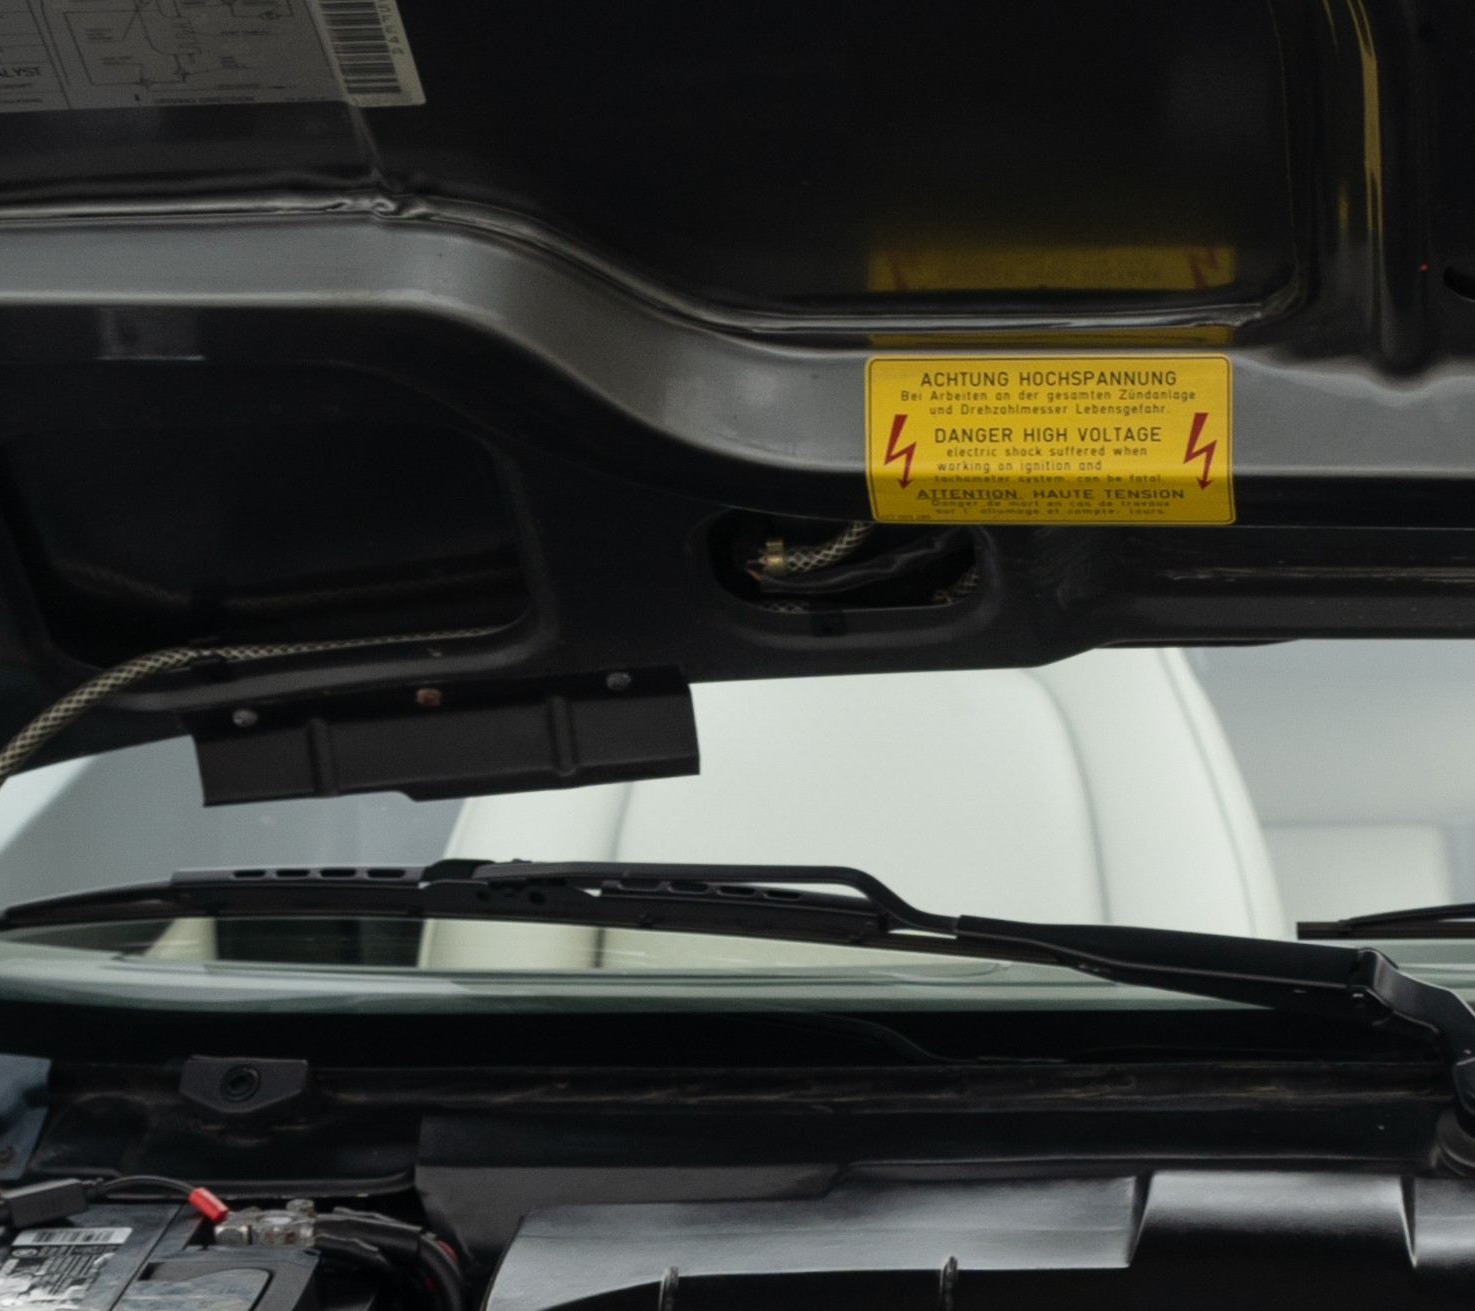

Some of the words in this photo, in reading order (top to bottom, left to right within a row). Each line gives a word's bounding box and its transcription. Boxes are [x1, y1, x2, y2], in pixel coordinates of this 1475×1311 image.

[920, 371, 1009, 388] ACHTUNG
[1018, 370, 1177, 387] HOCHSPANNUNG
[900, 389, 923, 402] Bei
[929, 389, 988, 402] Arbeiten
[994, 391, 1011, 402] an
[1017, 388, 1039, 402] der
[1046, 389, 1112, 404] gesamten
[1118, 387, 1196, 404] Zündanlage
[928, 403, 954, 416] und
[960, 403, 1069, 416] Drehzahlmesser
[934, 427, 1014, 444] DANGER
[1022, 426, 1069, 443] HIGH
[1077, 426, 1163, 443] VOLTAGE
[946, 445, 998, 458] electric
[1004, 445, 1042, 458] shock
[1048, 444, 1106, 458] suffered
[1113, 444, 1148, 457] when
[936, 459, 992, 475] working
[997, 461, 1014, 472] on
[1019, 458, 1072, 474] ignition
[1078, 458, 1102, 472] and
[933, 474, 1011, 484] tachometer
[1078, 474, 1100, 483] can
[1106, 474, 1124, 483] be
[1032, 488, 1094, 500] HAUTE
[1105, 488, 1185, 500] TENSION
[931, 499, 979, 509] Danger
[986, 499, 1002, 508] de
[1007, 498, 1040, 508] mort
[1046, 499, 1062, 508] en
[1068, 499, 1093, 508] cas
[1099, 498, 1118, 507] de
[1121, 498, 1172, 507] travaux
[934, 507, 959, 516] sur
[979, 507, 1038, 518] allumage
[1047, 506, 1062, 515] et
